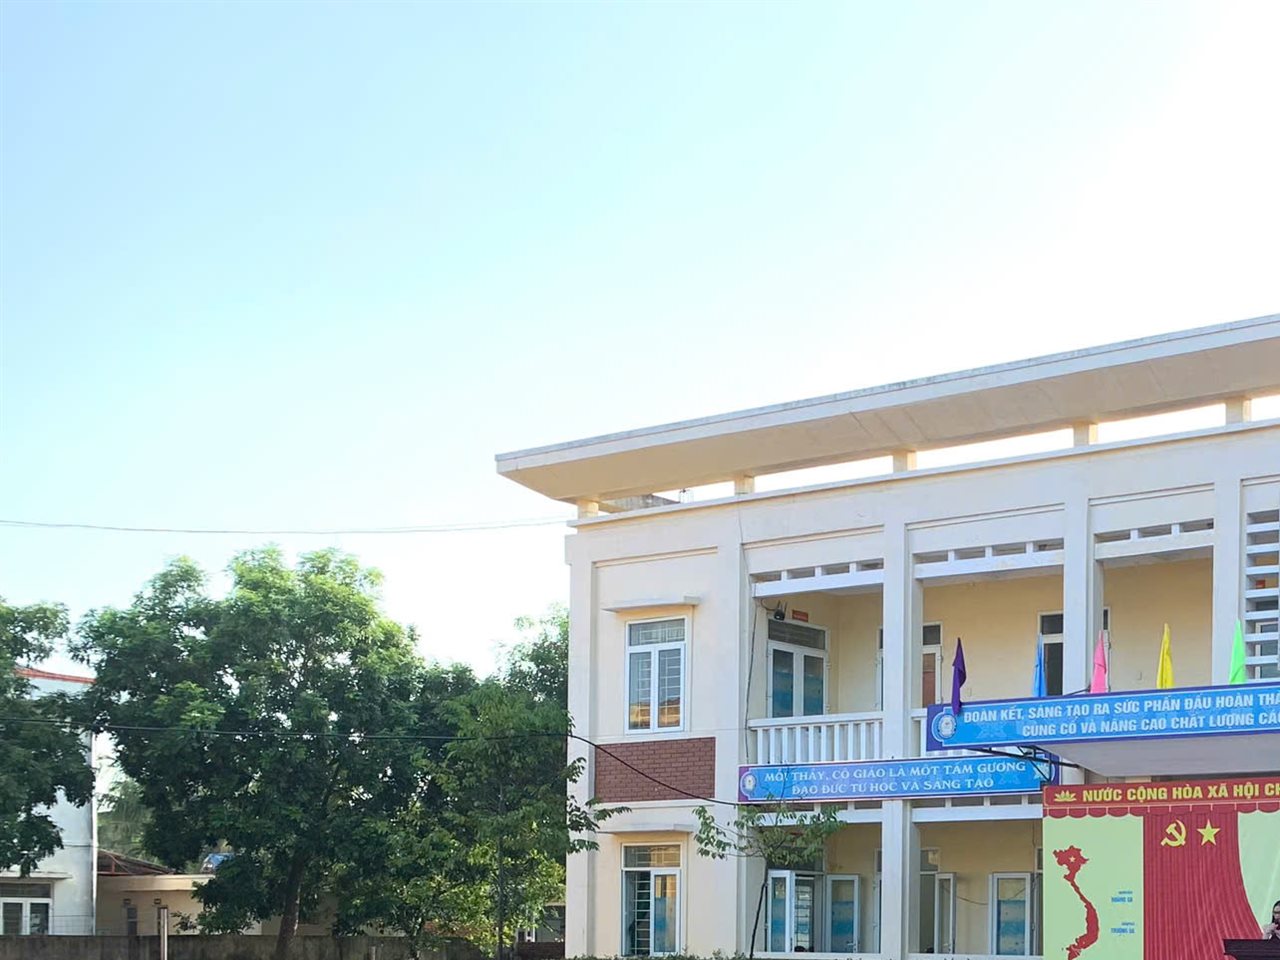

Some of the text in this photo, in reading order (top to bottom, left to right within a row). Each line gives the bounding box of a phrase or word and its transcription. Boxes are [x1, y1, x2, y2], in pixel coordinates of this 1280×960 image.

[1093, 703, 1110, 716] RA
[1141, 716, 1167, 732] CAO
[1082, 786, 1122, 802] NƯỚC
[1126, 785, 1168, 803] CỘNG
[1172, 783, 1203, 799] HÒA
[1207, 782, 1229, 799] XÃ
[1233, 781, 1260, 801] HỘI
